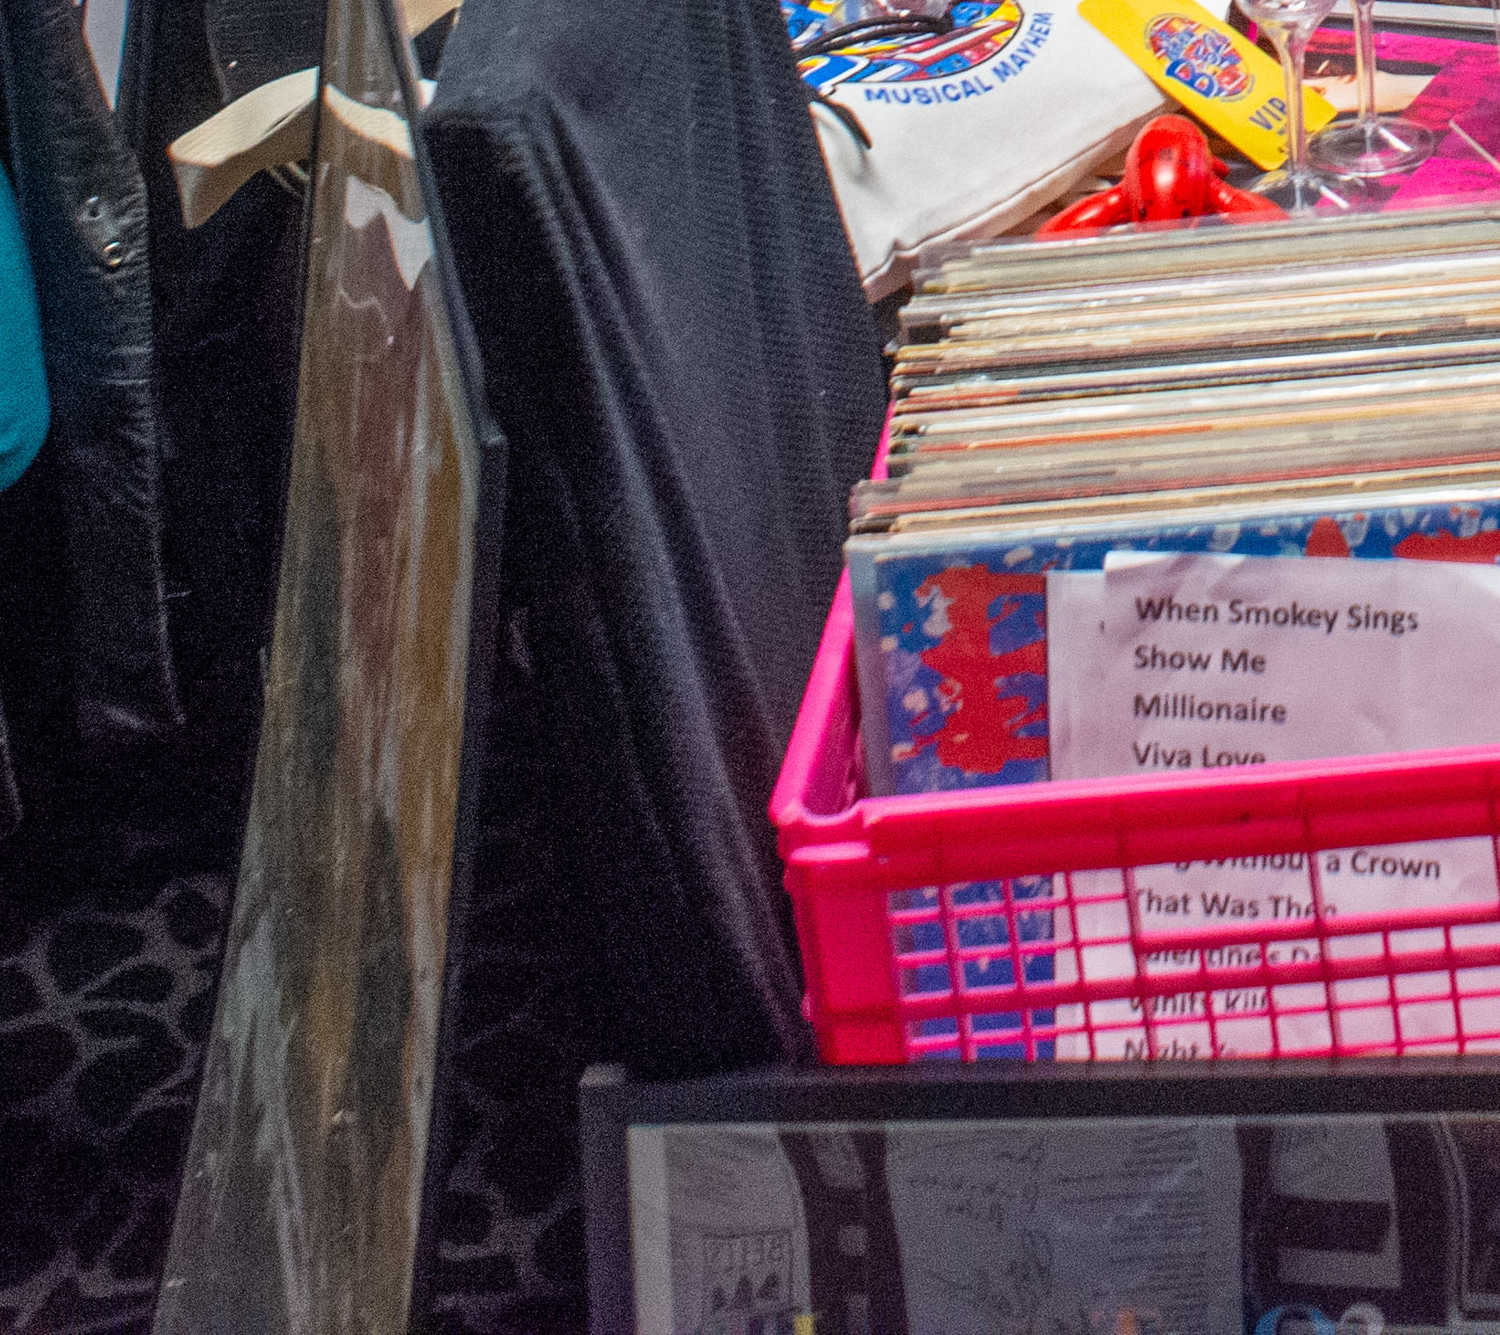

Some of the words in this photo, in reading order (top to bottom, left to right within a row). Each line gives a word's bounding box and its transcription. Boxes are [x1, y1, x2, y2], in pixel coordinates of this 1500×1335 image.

[865, 75, 994, 106] MUSICAL
[999, 12, 1055, 84] MAYHEM
[1248, 97, 1289, 132] VIP
[1135, 597, 1220, 623] When
[1228, 598, 1338, 634] Smokey
[1348, 605, 1419, 637] Sings
[1135, 645, 1212, 673] Show
[1221, 649, 1267, 674] Me
[1132, 694, 1288, 724] Millionaire
[1132, 742, 1193, 769] Viva
[1202, 745, 1266, 768] Love
[1325, 855, 1342, 874] a
[1351, 848, 1442, 880] Crown
[1200, 891, 1261, 919] Was
